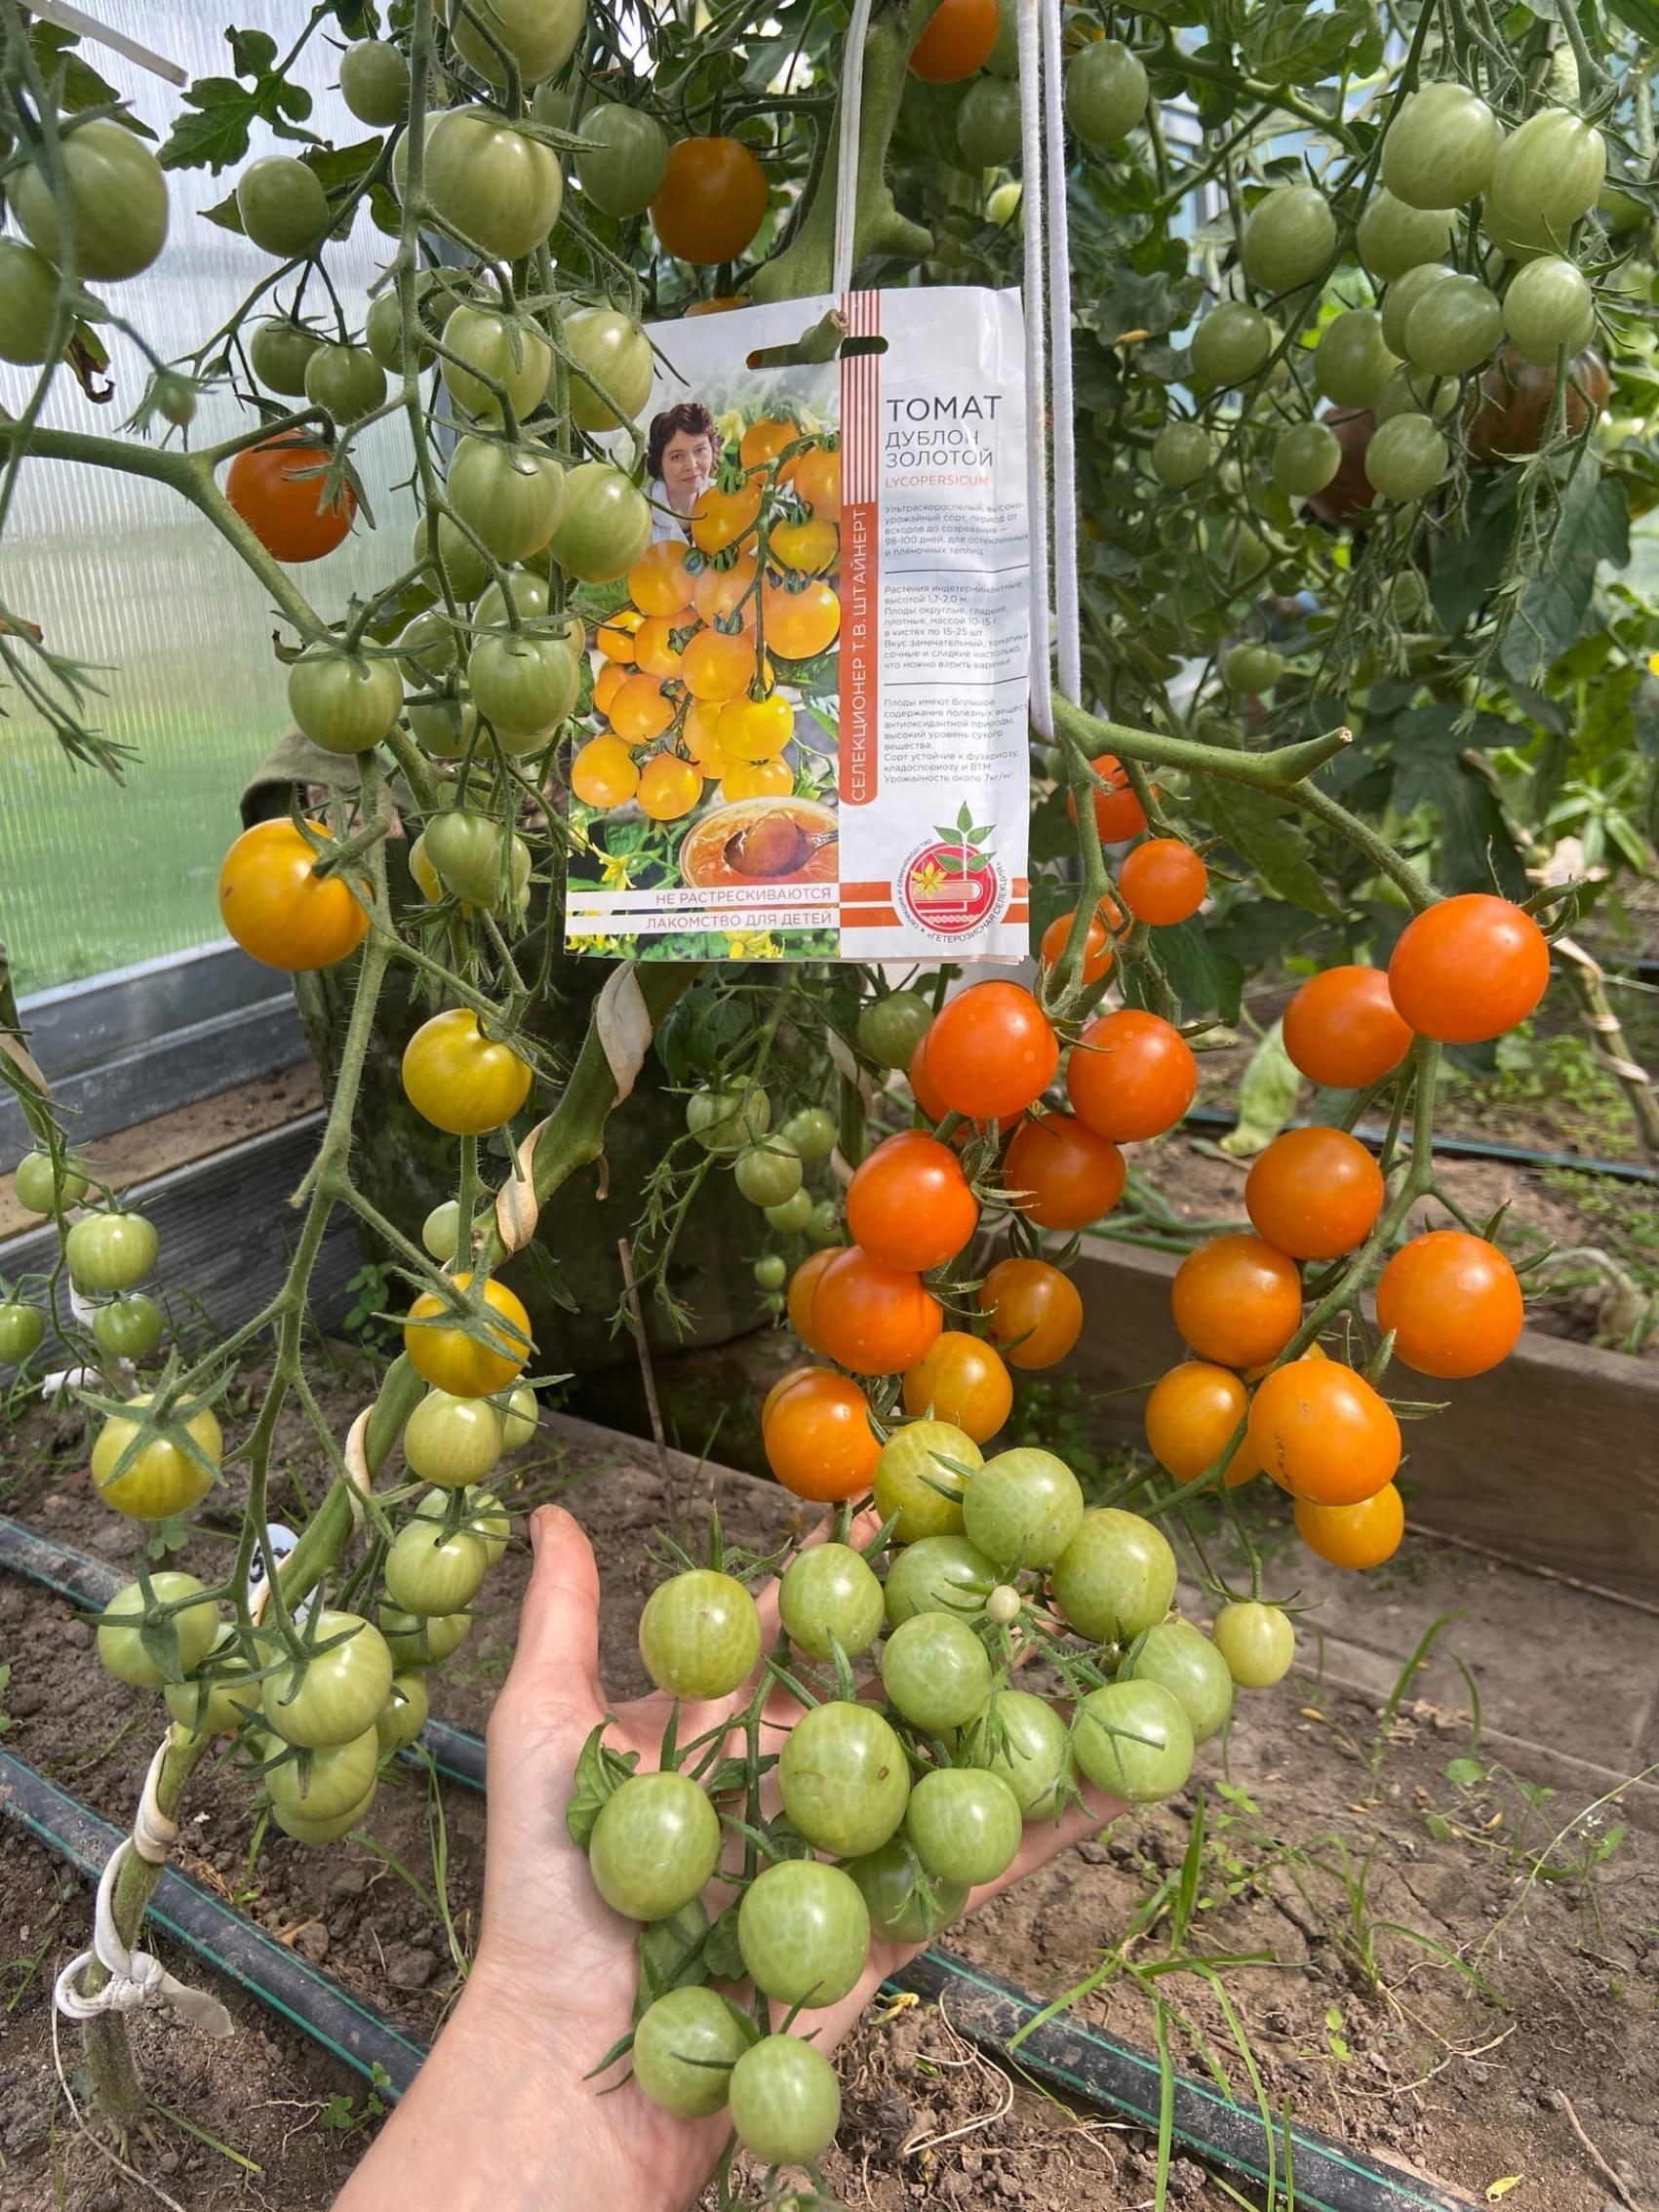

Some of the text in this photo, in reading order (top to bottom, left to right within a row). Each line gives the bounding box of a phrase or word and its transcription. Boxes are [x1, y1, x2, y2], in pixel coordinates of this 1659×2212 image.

[887, 395, 1003, 422] ТОМАТ
[886, 429, 978, 450] ДУБЛОН
[886, 448, 993, 469] ЗОЛОТОЙ
[886, 475, 989, 488] LYCOPERSICUM
[885, 513, 940, 525] урожайный
[885, 526, 924, 534] всходов
[885, 535, 916, 545] 98-100
[885, 585, 928, 594] Растения
[885, 595, 926, 604] высотой
[968, 617, 991, 626] 10-15
[885, 640, 906, 649] Вкус
[850, 509, 866, 801] СЕЛЕКЦИОНЕР Т.В. ШТАЙНЕРТ
[885, 698, 916, 707] Плоды
[885, 709, 943, 719] содержание
[885, 719, 968, 729] антиоксидантной
[885, 730, 1003, 739] высокий уровень сухого
[885, 753, 908, 762] Сорт
[912, 752, 956, 761] устойчив
[885, 764, 959, 772] кладоспориозу
[885, 774, 949, 783] Урожайность
[656, 888, 831, 905] НЕ РАСТРЕСКИВАЮТСЯ
[647, 911, 831, 928] ЛАКОМСТВО ДЛЯ ДЕТЕЙ
